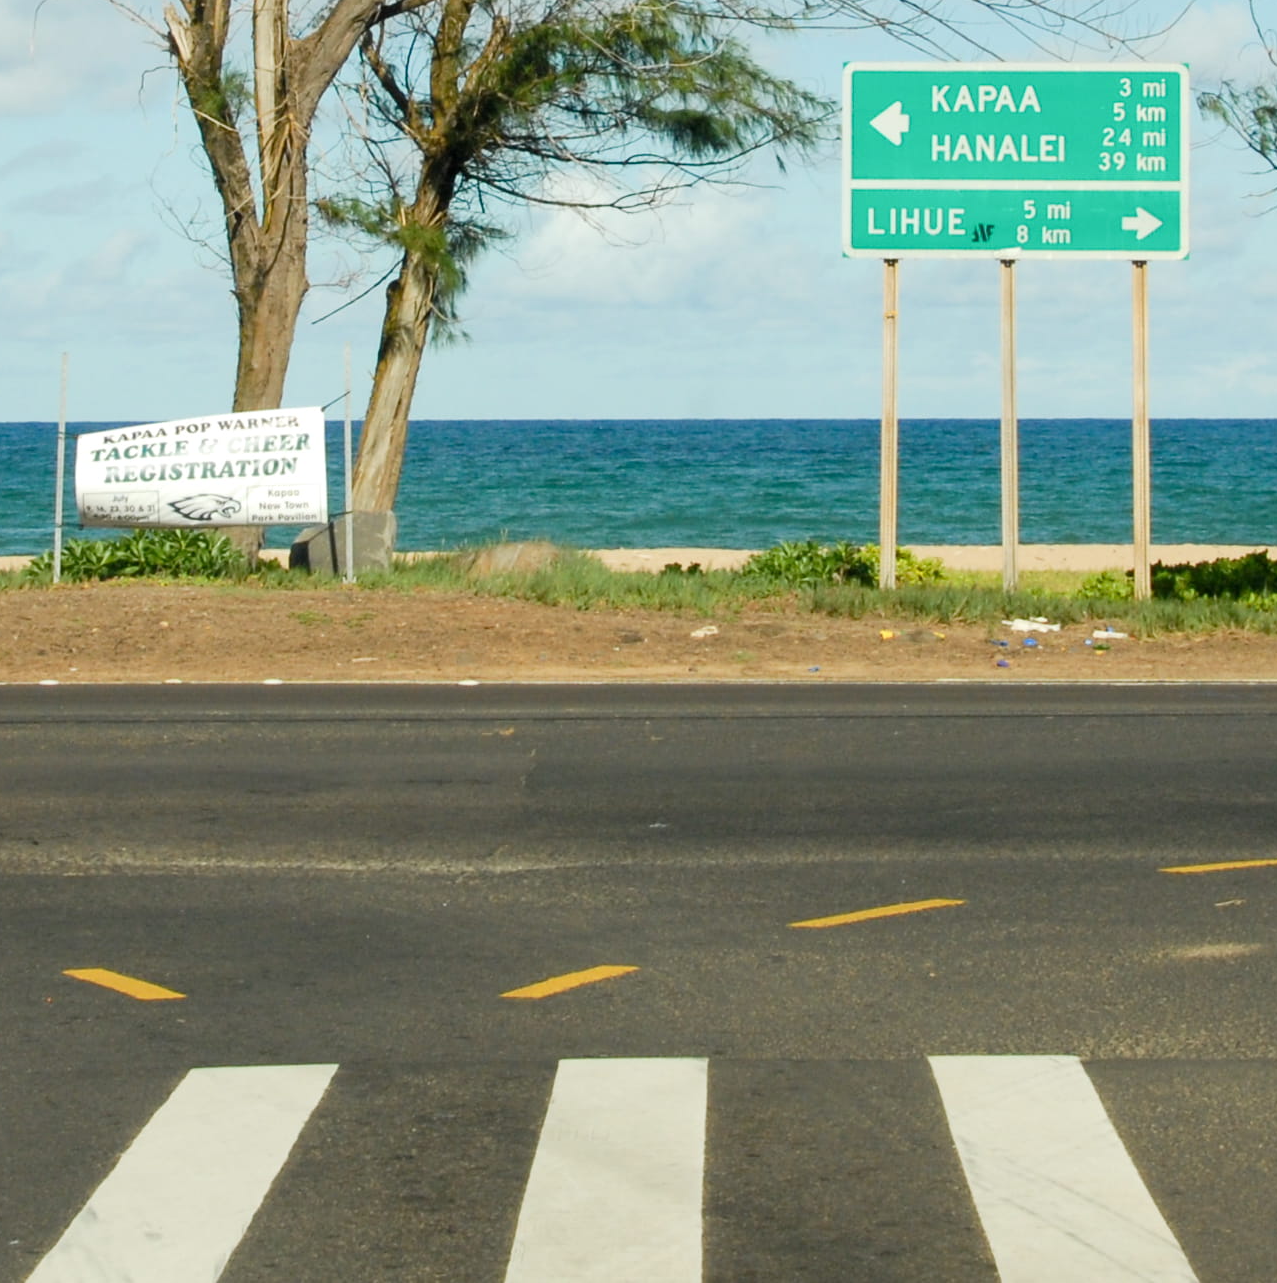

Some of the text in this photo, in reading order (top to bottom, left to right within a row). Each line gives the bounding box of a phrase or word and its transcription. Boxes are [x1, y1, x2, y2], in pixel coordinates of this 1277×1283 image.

[1119, 78, 1166, 98] 3 mi
[931, 85, 1041, 113] KAPAA
[1113, 102, 1166, 122] 5 km
[1102, 128, 1166, 147] 24 mi
[931, 134, 1065, 162] HANALEI
[1099, 152, 1166, 172] 39 km
[1024, 200, 1071, 220] 5 mi
[867, 208, 966, 235] LIHUE
[1016, 225, 1029, 244] 8
[1042, 225, 1071, 244] km
[103, 416, 299, 444] KAPAA POP WARNER
[90, 440, 189, 462] TACKLE
[227, 433, 311, 454] CHEER
[104, 458, 298, 484] REGISTRATION
[268, 489, 300, 498] Kapaa
[285, 501, 309, 509] Town
[278, 512, 317, 520] Pavilion
